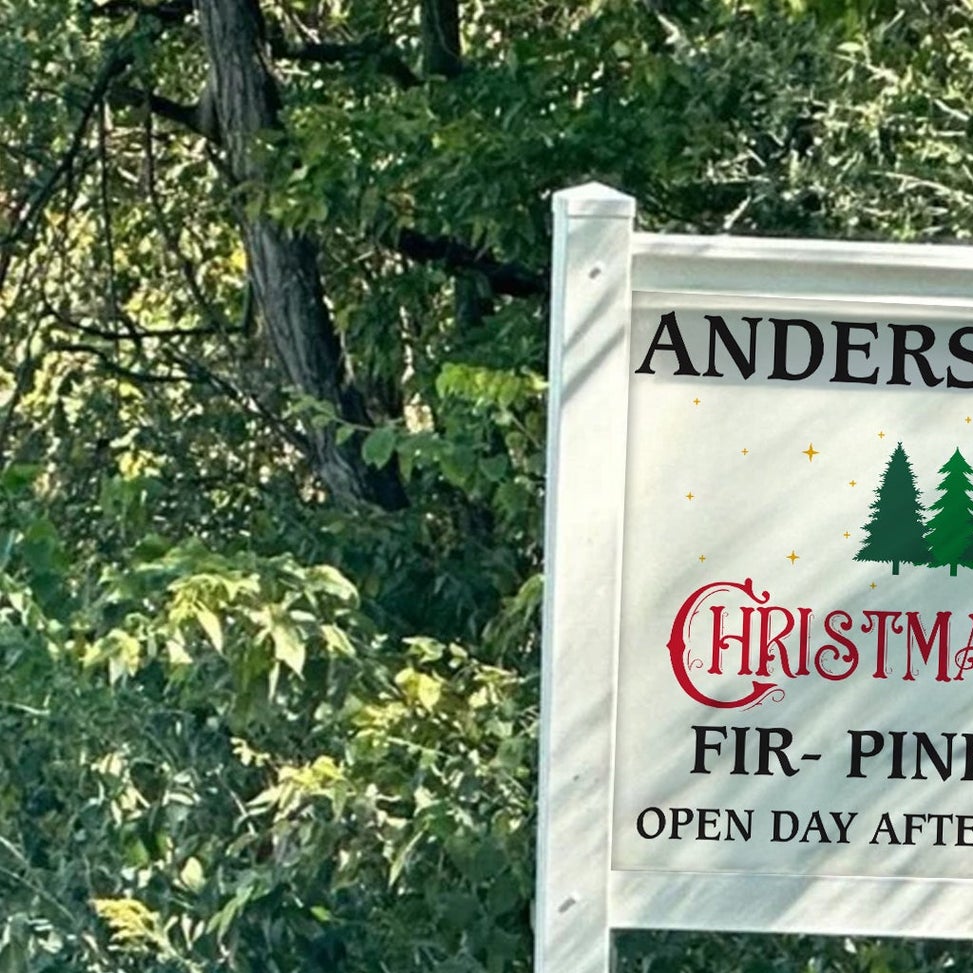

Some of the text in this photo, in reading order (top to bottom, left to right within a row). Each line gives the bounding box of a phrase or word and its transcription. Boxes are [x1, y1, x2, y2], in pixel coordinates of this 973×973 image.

[689, 725, 822, 777] FIR-
[636, 806, 755, 842] OPEN
[770, 810, 859, 844] DAY
